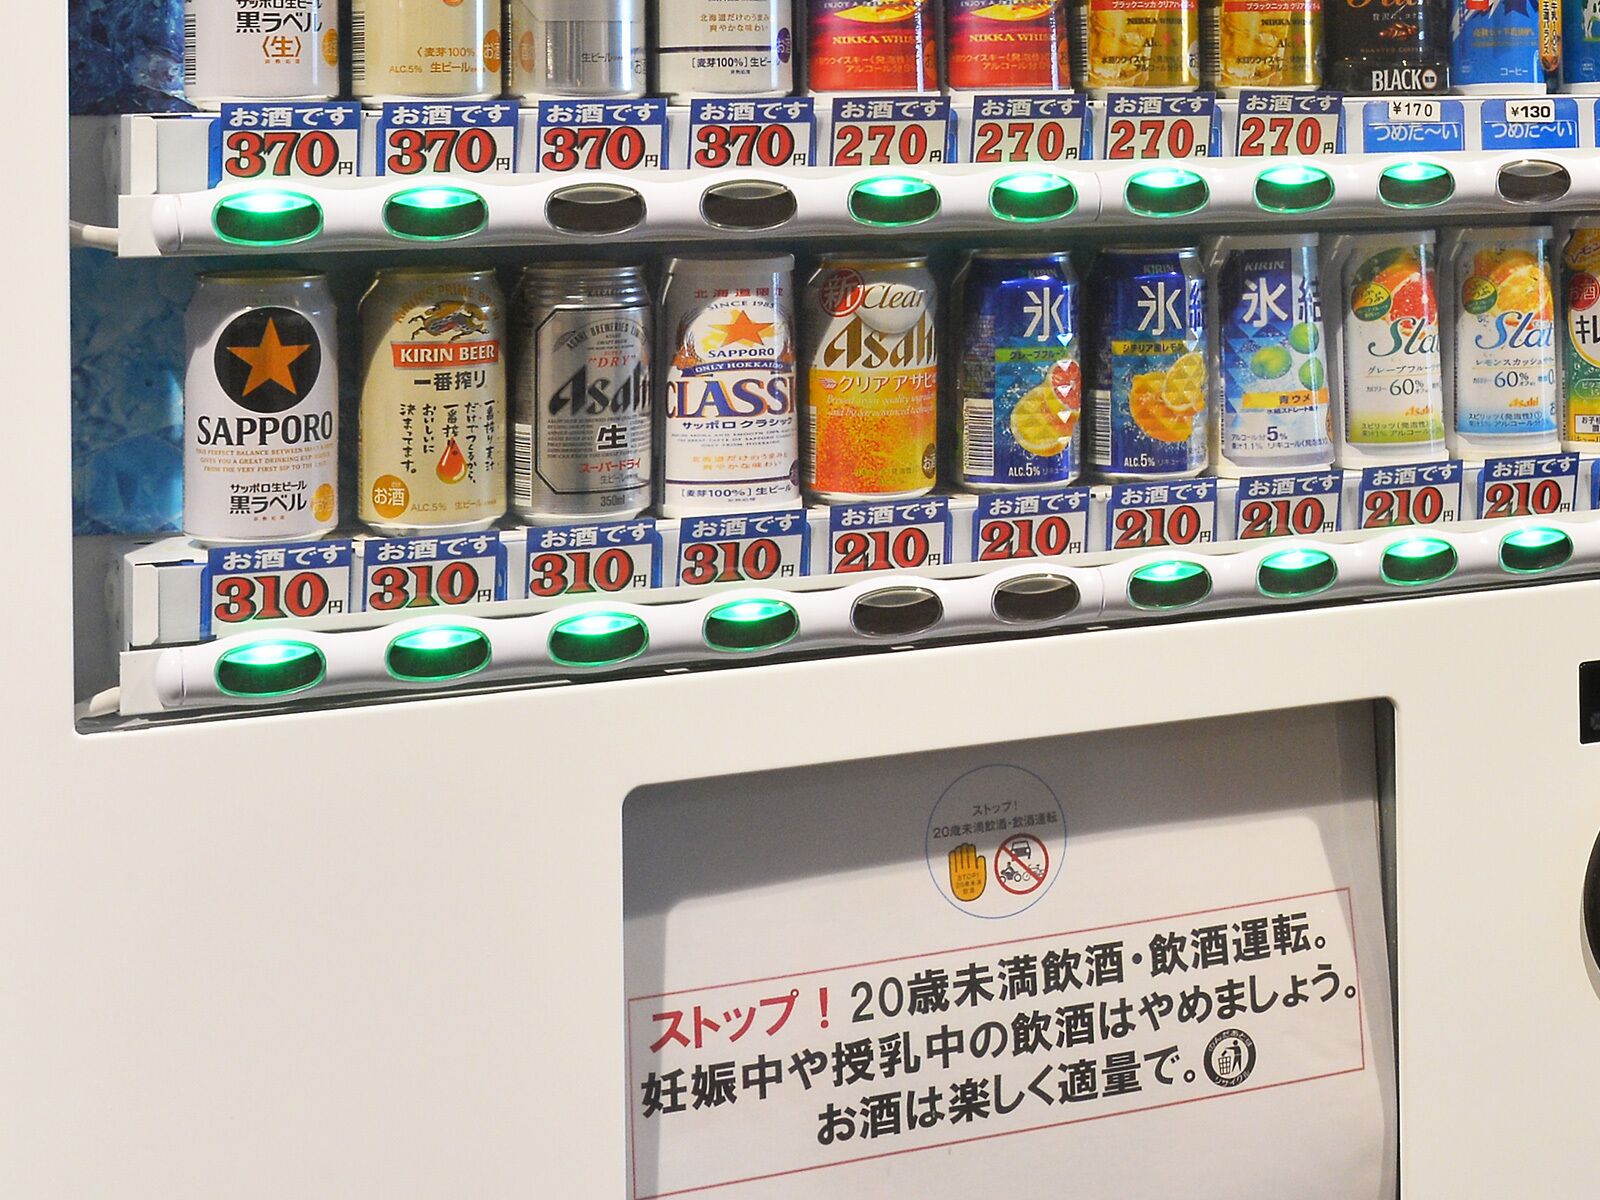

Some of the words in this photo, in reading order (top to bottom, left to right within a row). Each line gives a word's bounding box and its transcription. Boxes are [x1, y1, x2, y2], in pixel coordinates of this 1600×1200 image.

[236, 11, 323, 34] 黒ラベル
[1371, 68, 1422, 92] BLACK
[230, 105, 354, 128] お酒です
[840, 98, 949, 119] お酒です
[1392, 102, 1433, 120] ¥170
[225, 128, 353, 177] 370円
[695, 124, 806, 168] 370円
[834, 123, 942, 166] 270円
[1240, 116, 1334, 156] 270円
[1023, 287, 1066, 342] 氷
[400, 347, 453, 363] KIRIN
[459, 344, 495, 361] BEER
[1278, 393, 1312, 405] 青ウメ
[1008, 462, 1041, 478] ALC.5%
[373, 488, 405, 507] お酒
[1484, 478, 1570, 518] 210円
[1114, 505, 1211, 550] 210円
[682, 538, 794, 585] 310円
[834, 527, 940, 573] 210円
[214, 575, 343, 623] 310円
[650, 986, 832, 1053] ストップ！
[849, 912, 1328, 1023] 20歳未満飲酒・飲酒運転。
[640, 964, 1357, 1118] 妊娠中や授乳中の飲酒はやめましょう。
[816, 1045, 1199, 1147] お酒は楽しく適量で。
